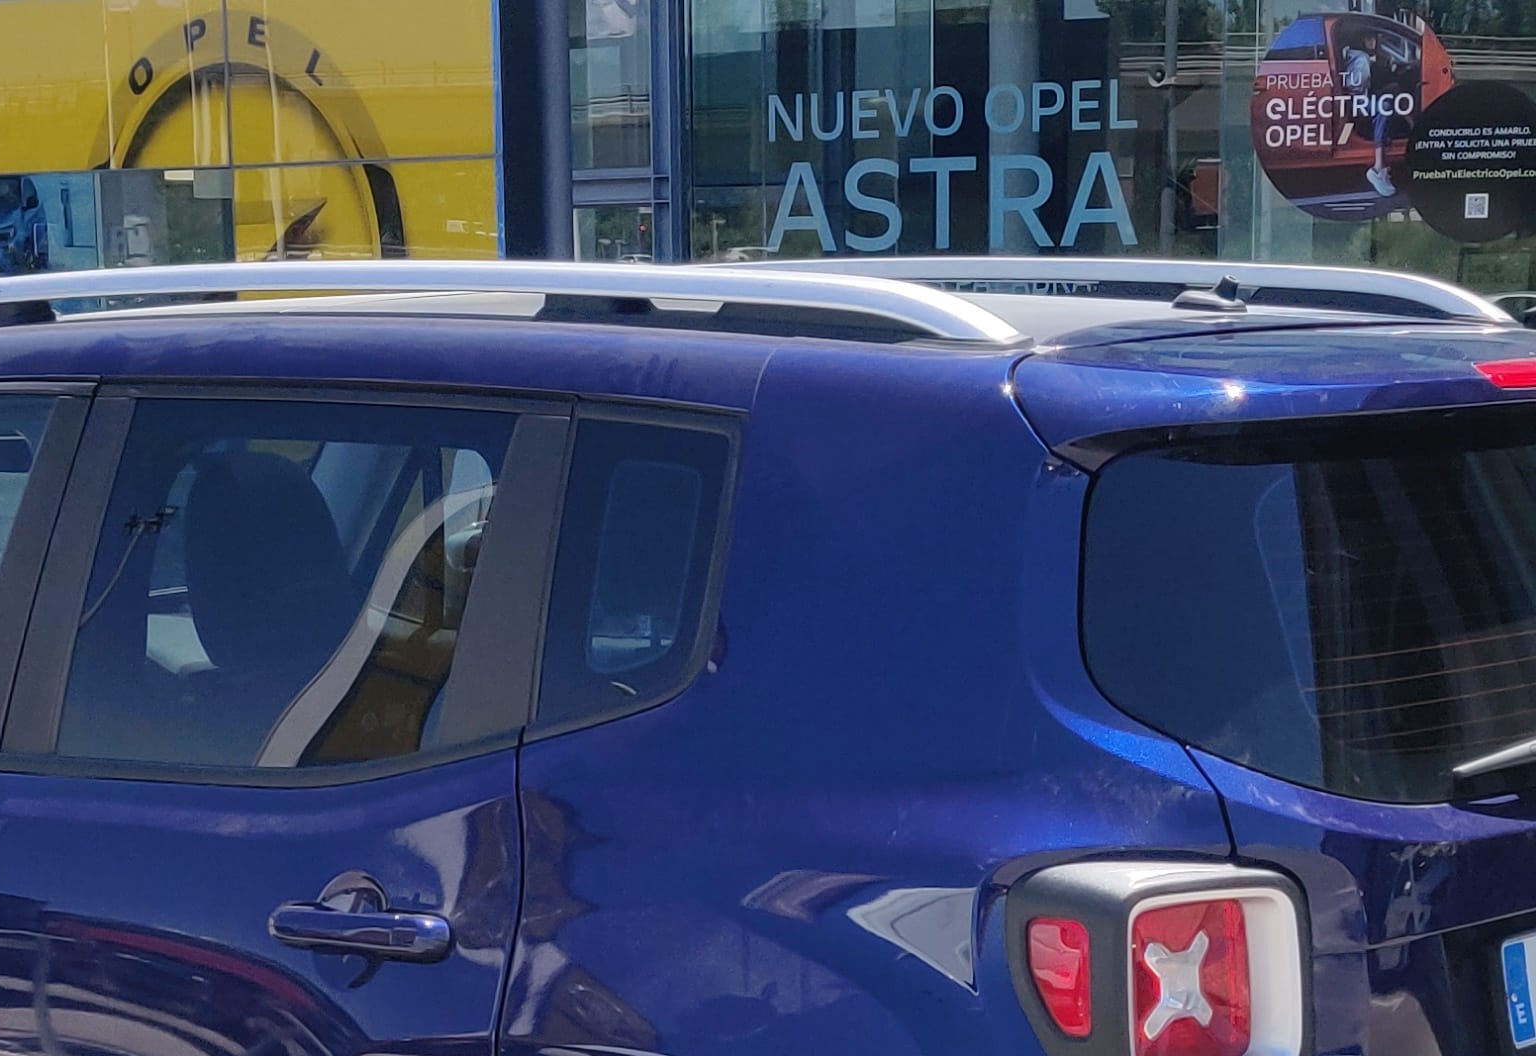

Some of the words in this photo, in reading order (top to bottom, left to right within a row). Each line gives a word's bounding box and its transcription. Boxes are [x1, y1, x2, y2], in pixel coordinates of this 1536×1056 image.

[128, 15, 324, 96] OPEL
[1266, 73, 1334, 91] PRUEBA
[1339, 71, 1363, 88] TU
[767, 85, 964, 143] NUEVO
[984, 78, 1139, 135] OPEL
[1265, 122, 1333, 148] OPEL
[1428, 127, 1481, 137] CONDUCIRLO
[1482, 127, 1493, 136] ES
[1441, 151, 1456, 160] SIN
[1457, 150, 1517, 160] COMPROMISO!
[1454, 139, 1490, 149] SOLICITA
[1491, 139, 1511, 148] UNA
[766, 151, 1139, 252] ASTRA
[1515, 1003, 1528, 1025] E
